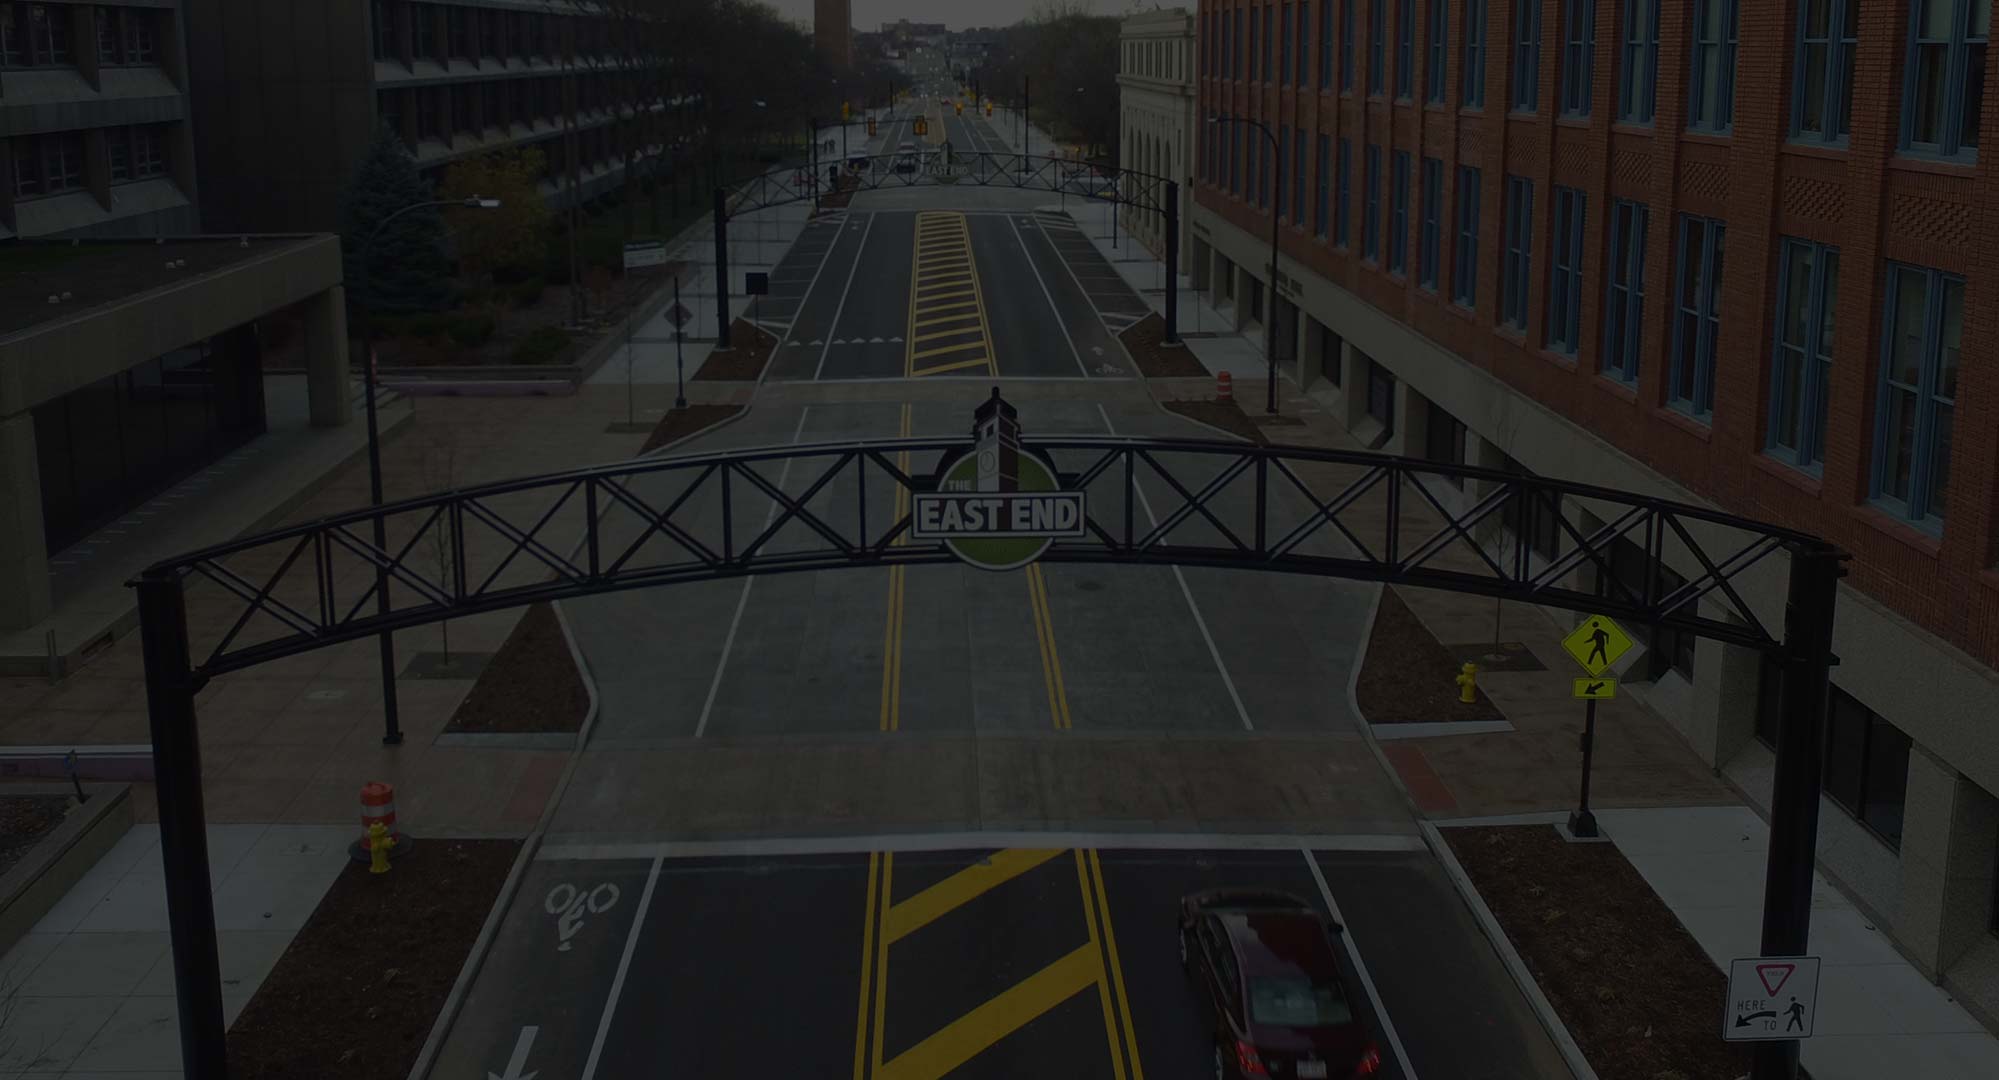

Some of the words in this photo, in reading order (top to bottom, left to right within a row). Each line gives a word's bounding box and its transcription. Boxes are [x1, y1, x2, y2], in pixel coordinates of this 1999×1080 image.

[949, 480, 972, 491] THE
[921, 499, 1004, 531] EAST
[1011, 498, 1077, 531] END
[1737, 1000, 1766, 1010] HERE
[1764, 1020, 1776, 1030] TO
